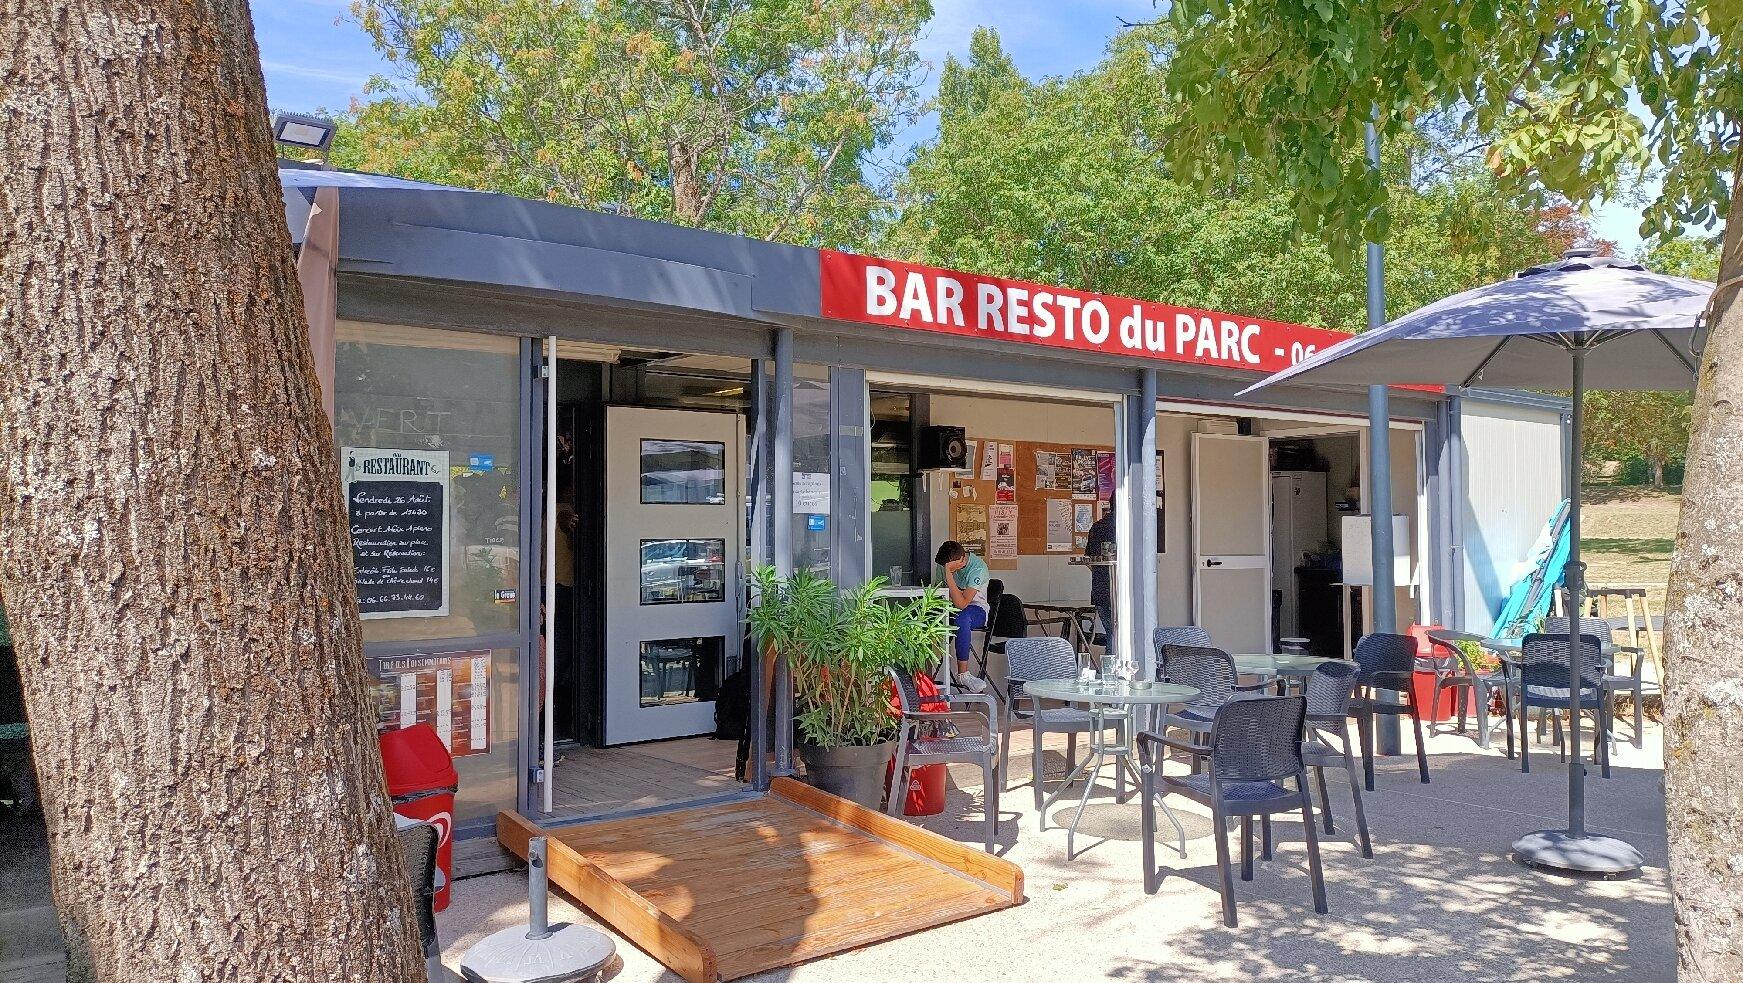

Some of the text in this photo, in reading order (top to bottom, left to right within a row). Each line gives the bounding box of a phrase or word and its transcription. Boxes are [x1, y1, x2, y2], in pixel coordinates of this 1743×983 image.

[866, 265, 965, 327] BAR
[977, 283, 1110, 345] RESTO
[1119, 304, 1165, 352] du
[1175, 313, 1260, 363] PARC
[362, 457, 431, 476] RESTAURANT
[352, 491, 392, 504] Vendredi
